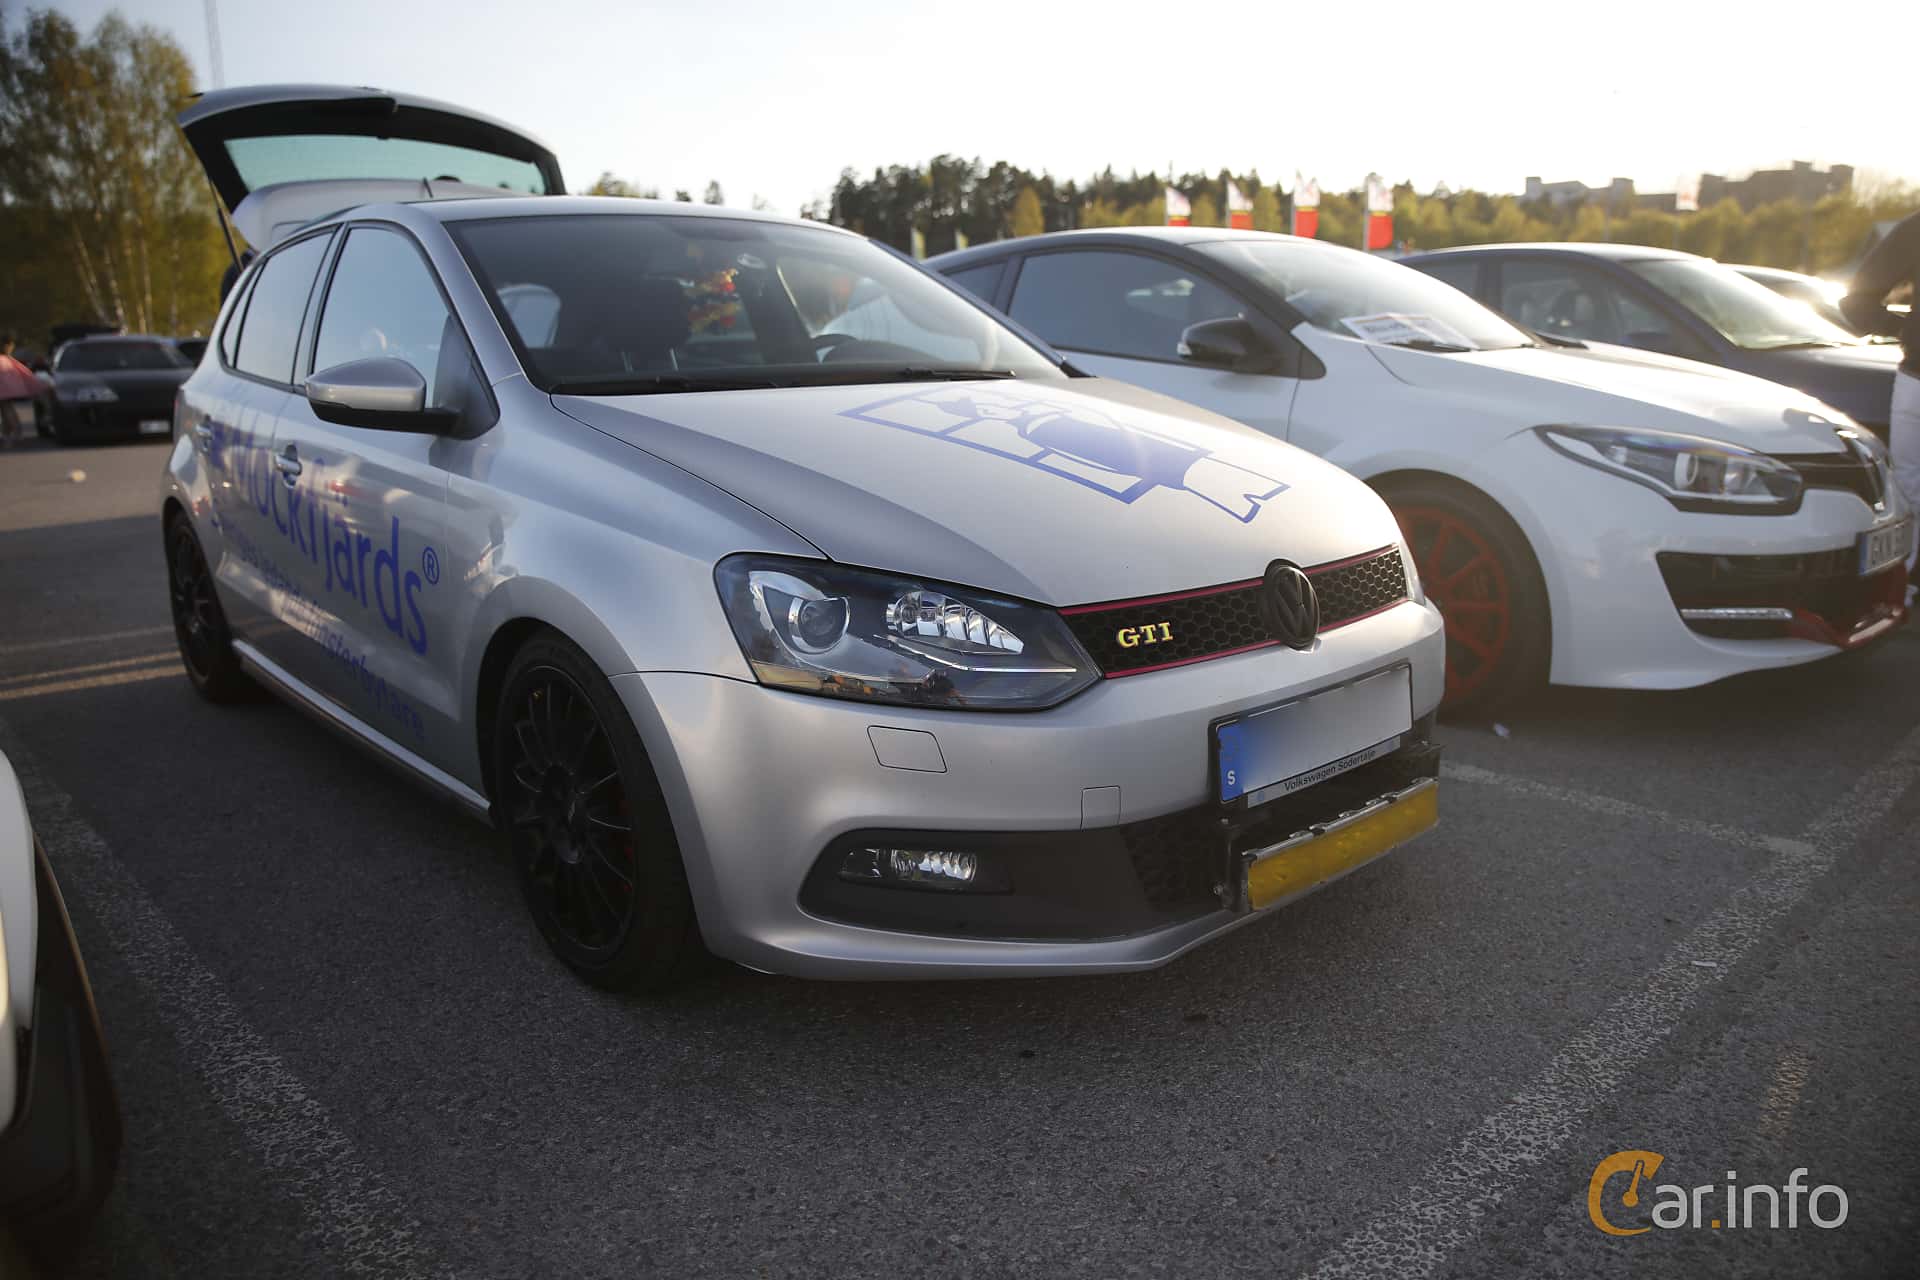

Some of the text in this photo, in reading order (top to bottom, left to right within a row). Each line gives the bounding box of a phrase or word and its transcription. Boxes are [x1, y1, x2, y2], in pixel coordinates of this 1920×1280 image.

[1117, 622, 1174, 648] GTI
[1227, 770, 1236, 785] S
[1284, 766, 1336, 791] Volkswagen
